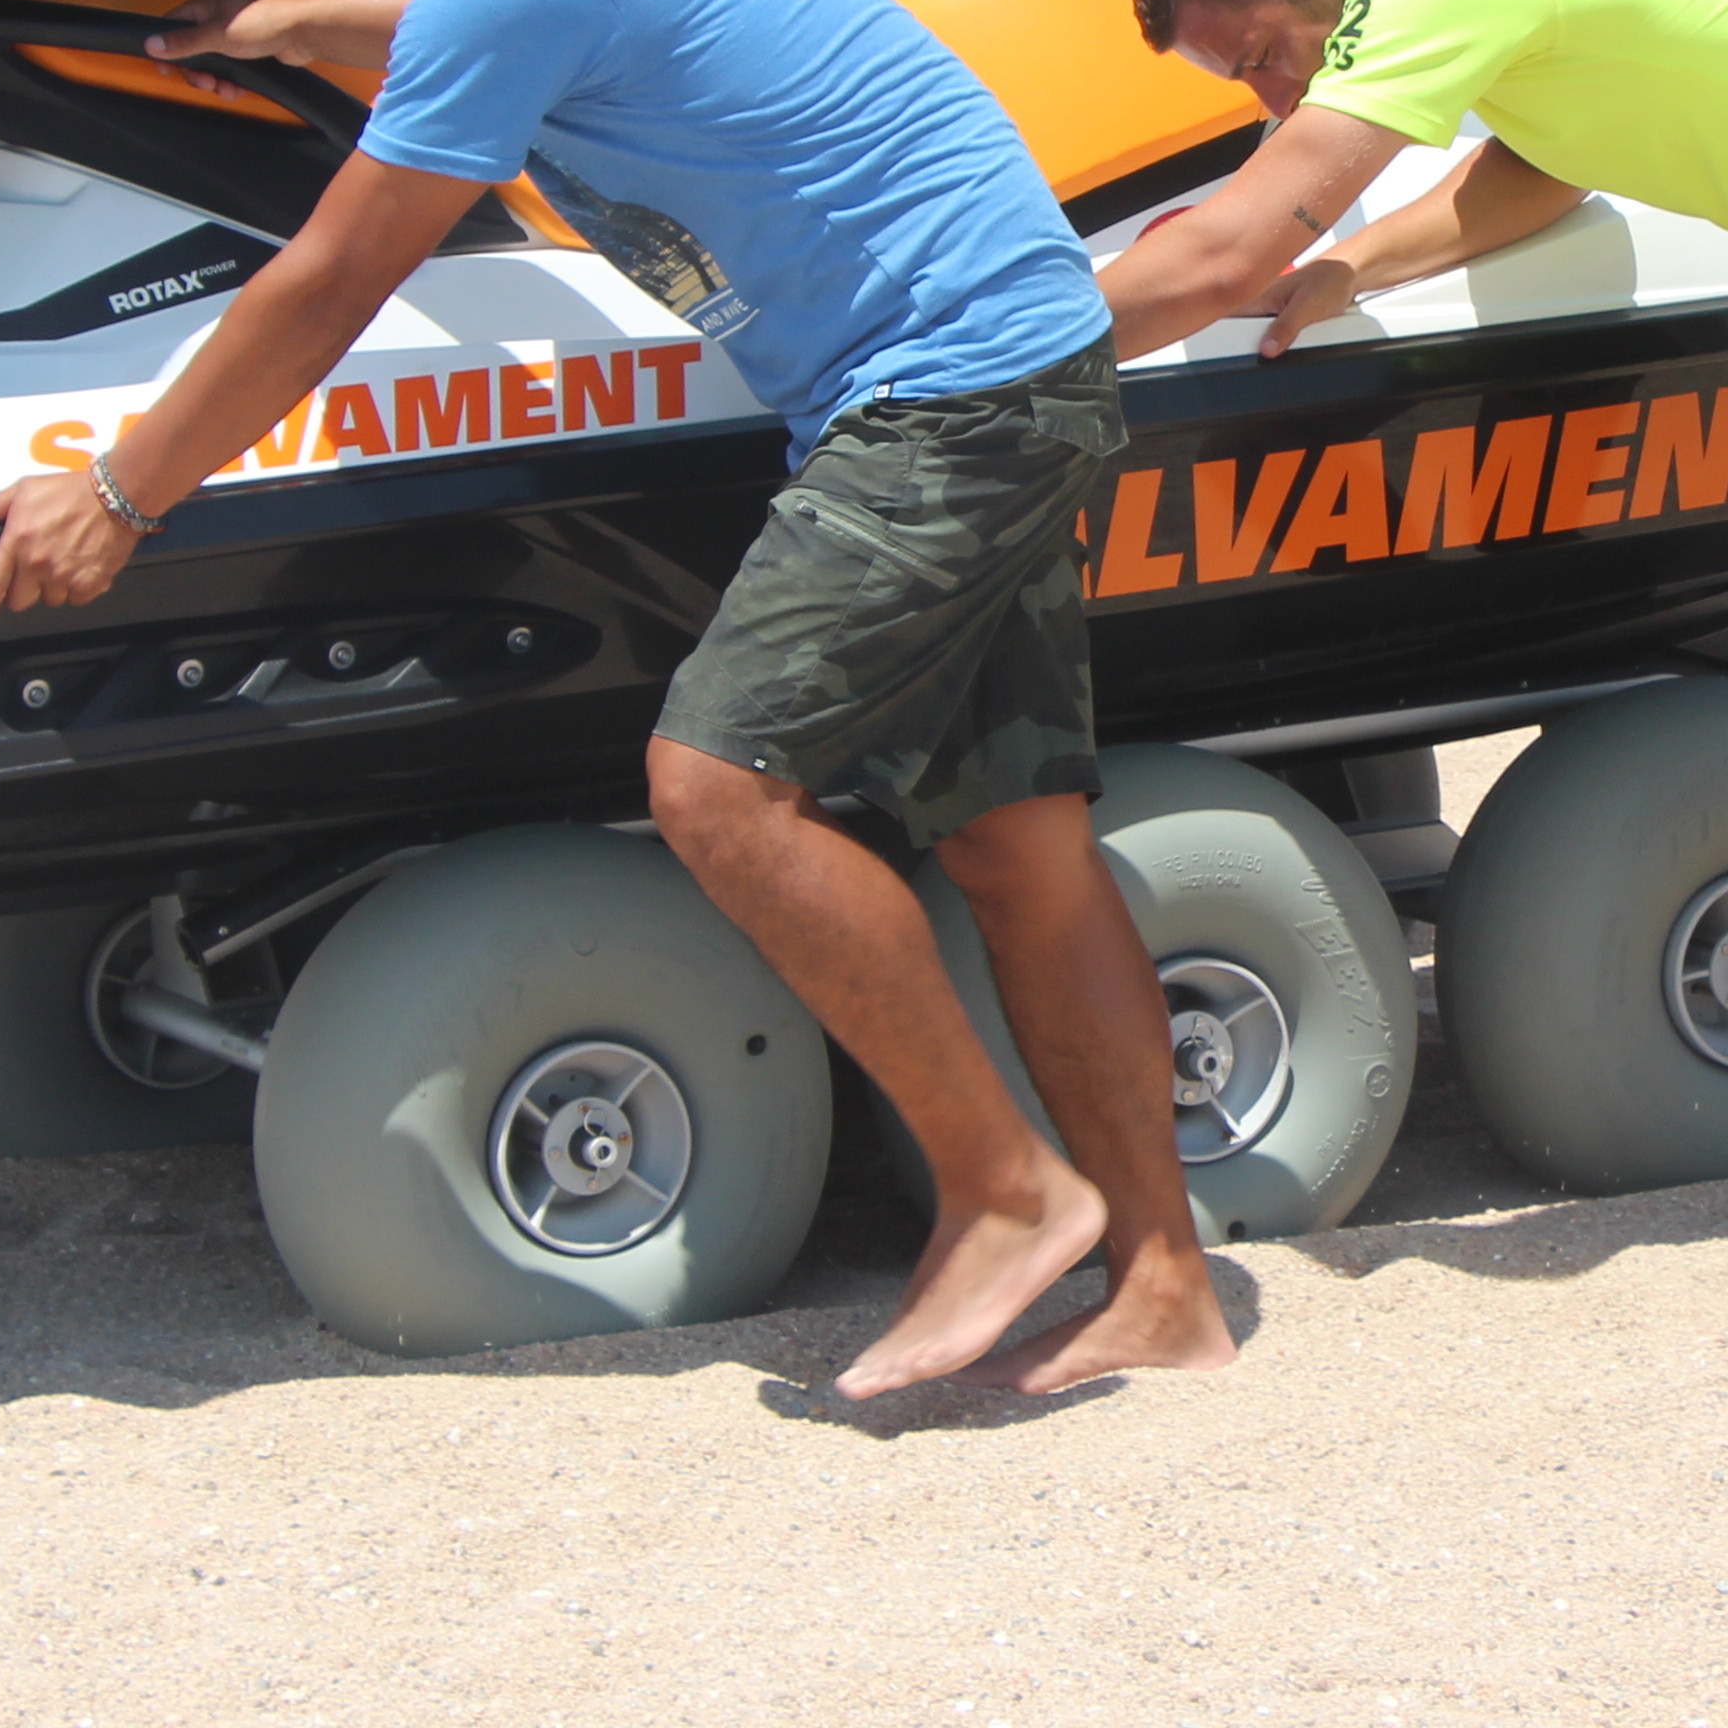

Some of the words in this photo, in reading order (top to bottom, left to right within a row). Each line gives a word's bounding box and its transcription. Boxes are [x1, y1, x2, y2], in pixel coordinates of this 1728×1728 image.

[108, 270, 205, 314] ROTAX
[199, 259, 237, 278] POWER
[29, 341, 702, 476] SVAMENT
